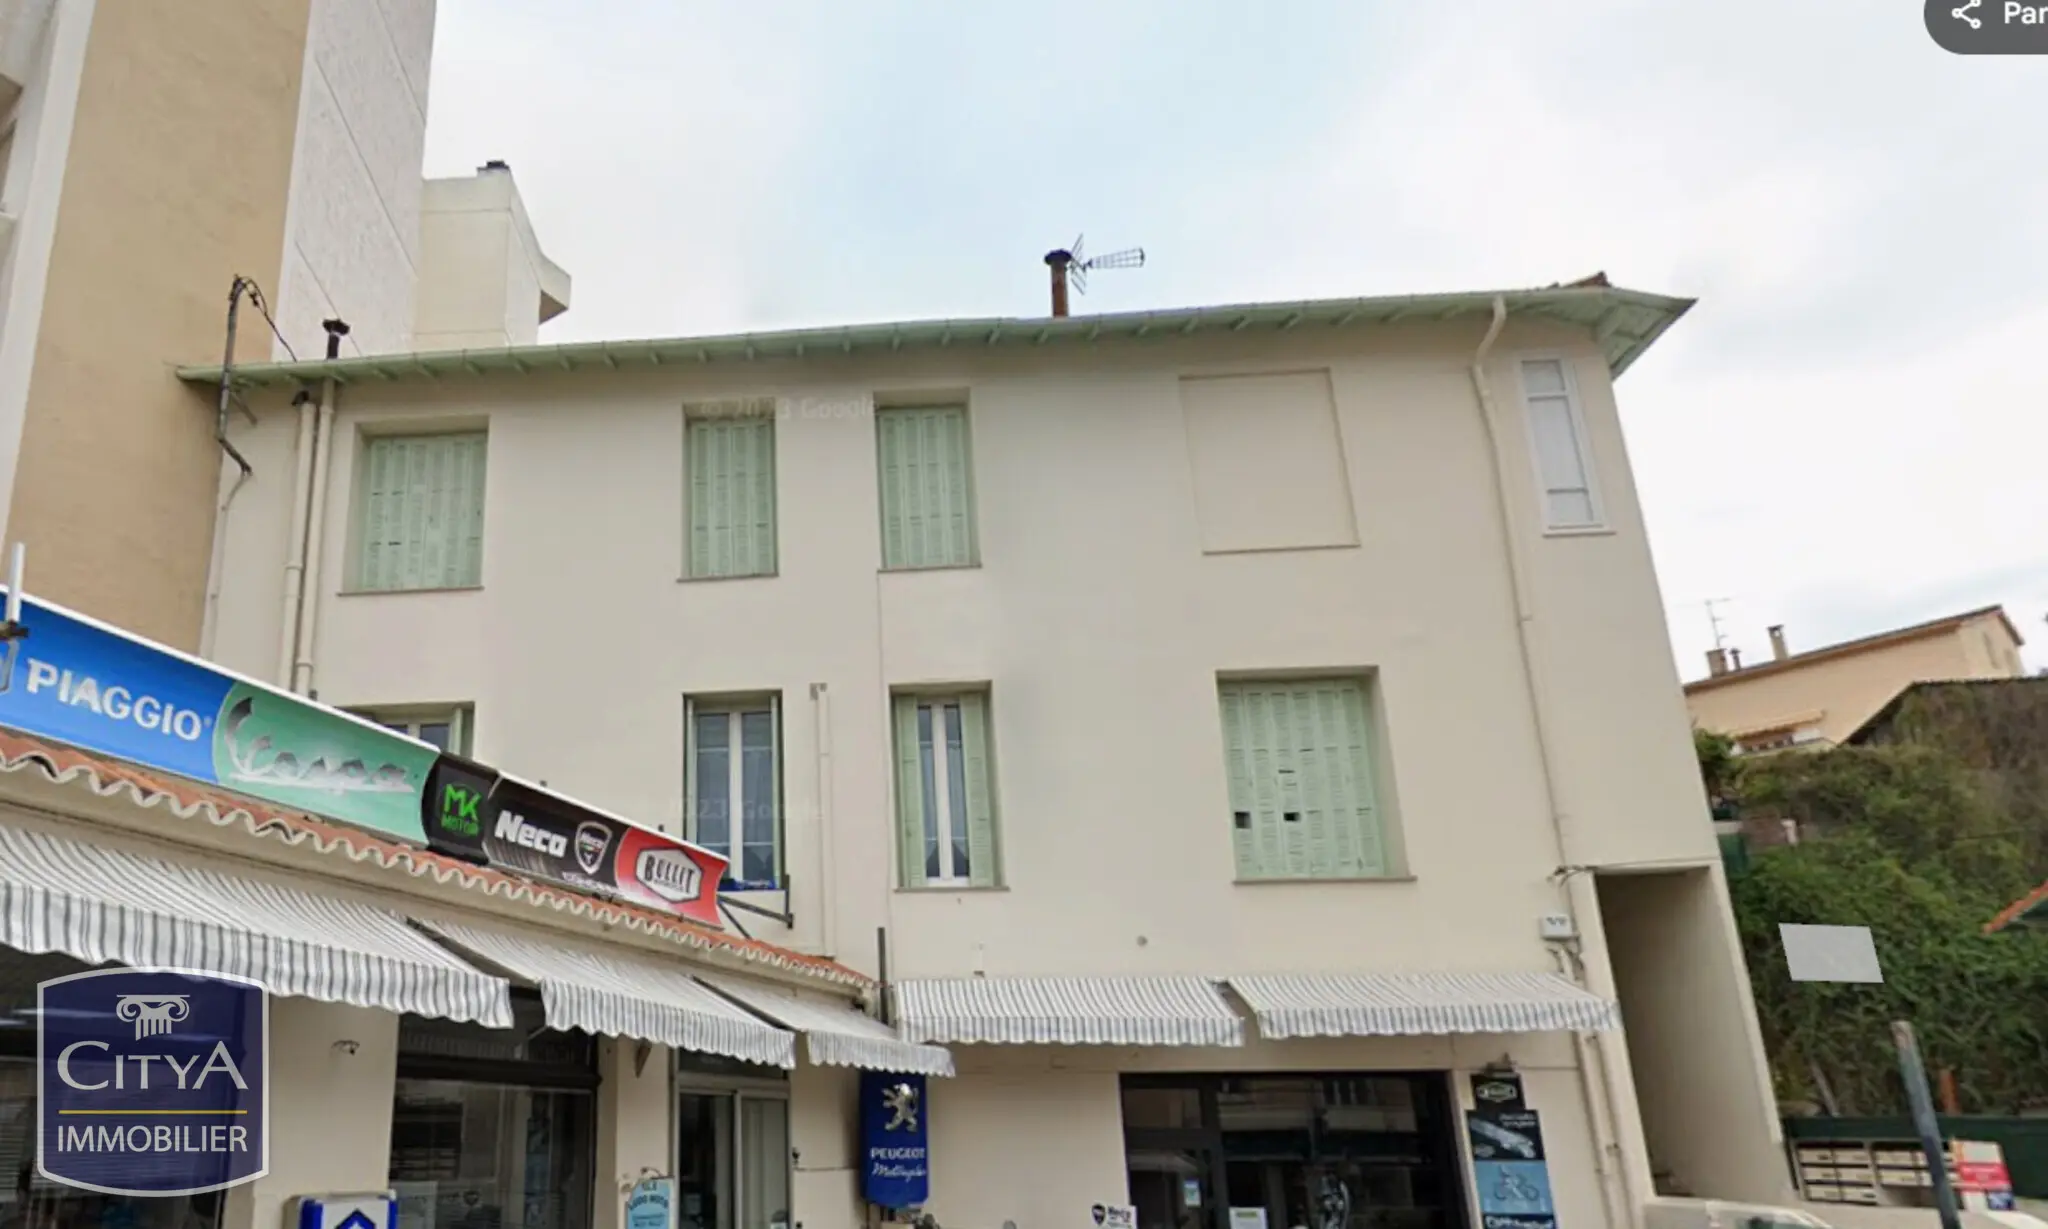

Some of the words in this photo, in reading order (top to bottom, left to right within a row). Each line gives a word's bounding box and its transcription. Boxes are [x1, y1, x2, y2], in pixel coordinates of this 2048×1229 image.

[27, 657, 202, 741] PIAGGIO
[443, 783, 483, 821] MK
[494, 810, 568, 857] Neco
[870, 1147, 925, 1160] PEUGEOT
